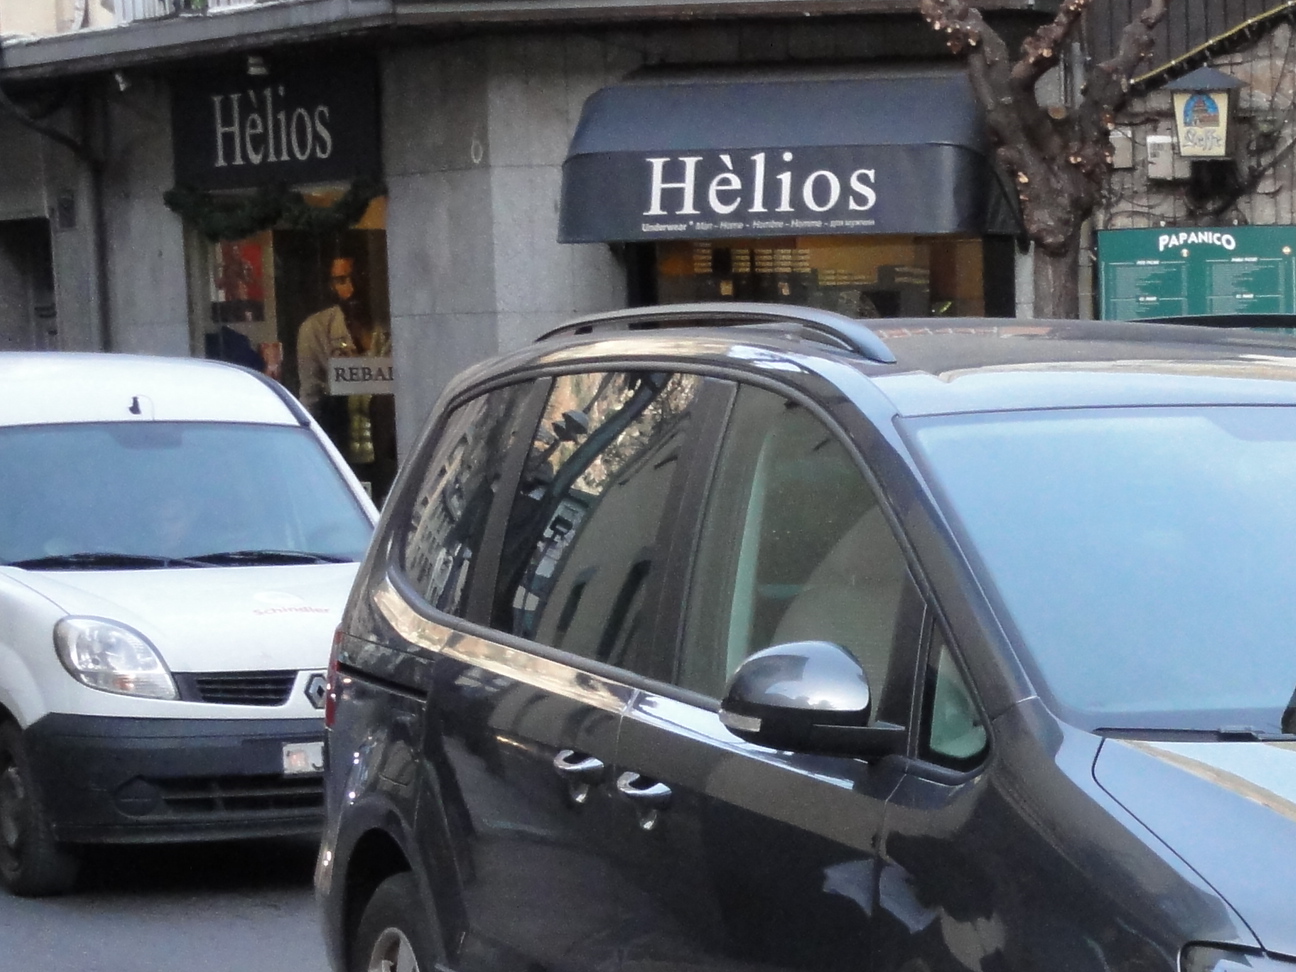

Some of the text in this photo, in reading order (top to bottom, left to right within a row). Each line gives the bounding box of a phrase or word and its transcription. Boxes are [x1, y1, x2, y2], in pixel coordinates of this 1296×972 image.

[211, 85, 333, 168] Hèlios
[1182, 126, 1222, 151] Leffe
[643, 151, 877, 216] Hèlios
[1158, 231, 1237, 252] PAPANICO
